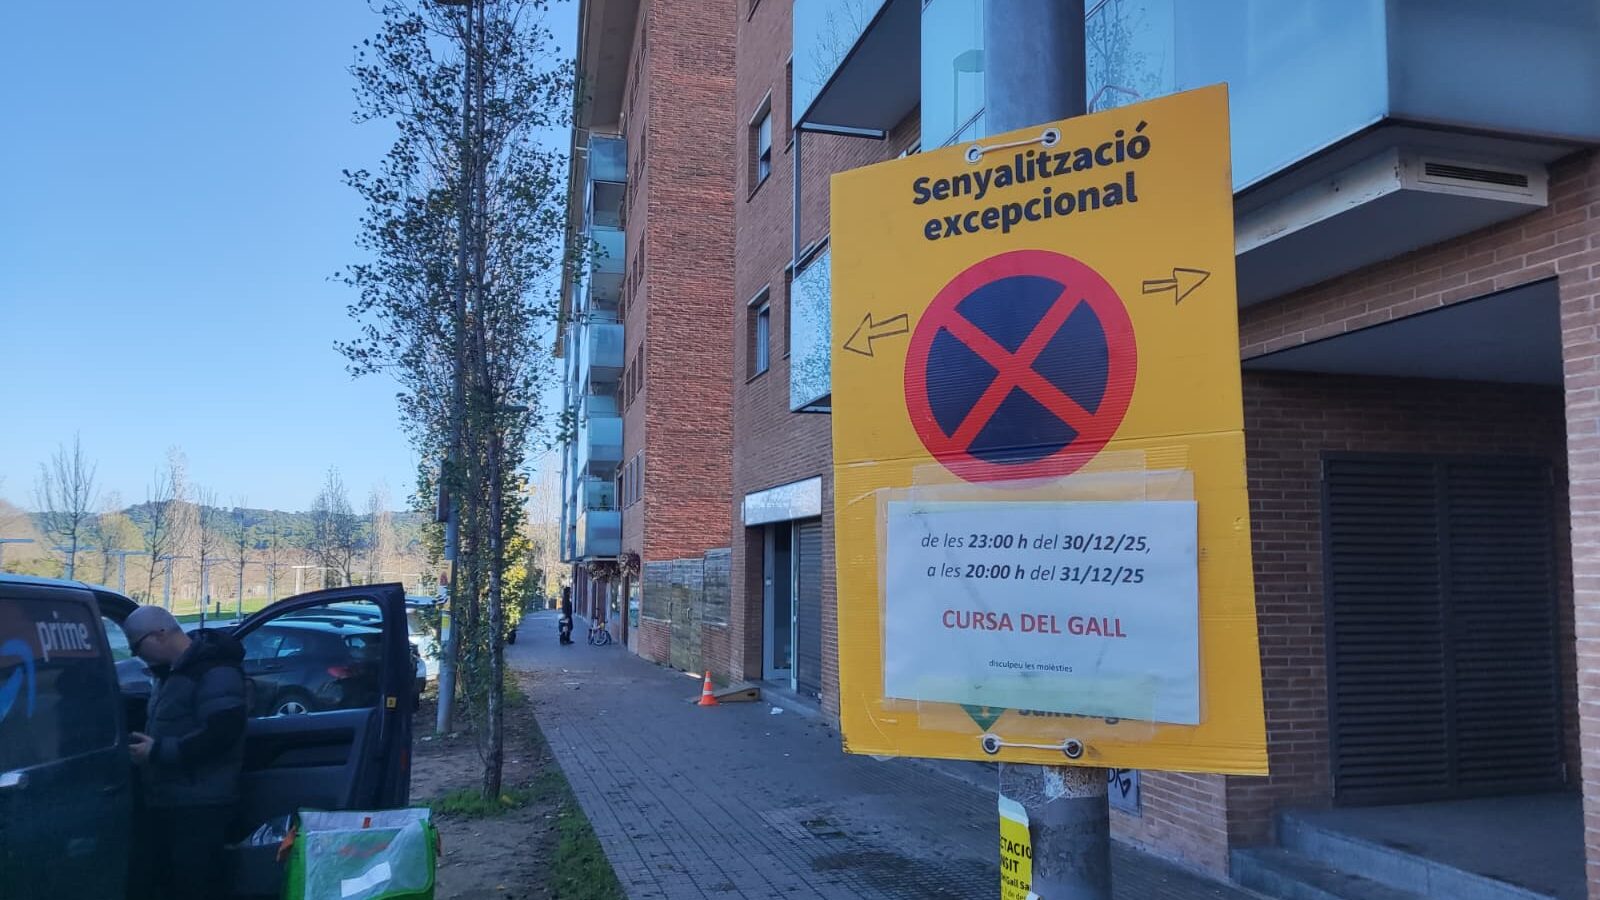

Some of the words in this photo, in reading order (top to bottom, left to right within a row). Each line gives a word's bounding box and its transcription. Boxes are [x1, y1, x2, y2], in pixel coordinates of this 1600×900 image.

[912, 120, 1151, 205] Senyalització
[923, 171, 1138, 241] excepcional
[921, 533, 939, 548] de
[943, 533, 964, 548] les
[968, 534, 1014, 549] 23:00
[1018, 534, 1028, 549] h
[1033, 534, 1058, 550] del
[1062, 533, 1151, 554] 30/12/25,
[927, 566, 936, 577] a
[941, 563, 961, 578] les
[965, 564, 1011, 579] 20:00
[1014, 565, 1025, 580] h
[1030, 565, 1056, 581] del
[1060, 565, 1145, 586] 31/12/25
[35, 610, 91, 663] prime
[942, 609, 1014, 632] CURSA
[1020, 613, 1062, 635] DEL
[1067, 616, 1127, 638] GALL
[989, 659, 1023, 670] disculpeu
[1025, 661, 1035, 671] les
[1036, 663, 1073, 673] molèsties
